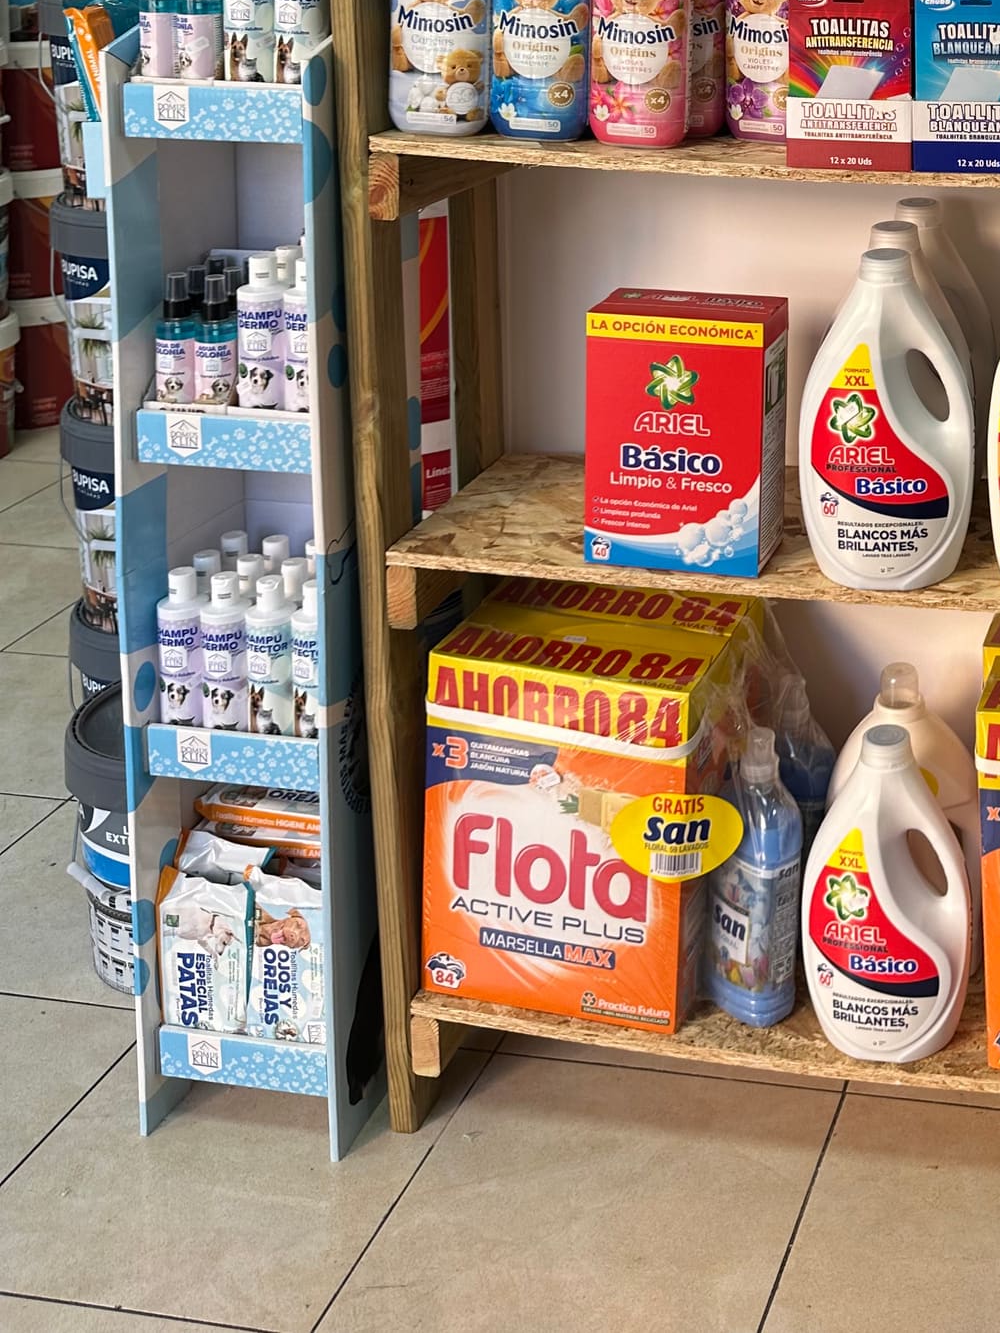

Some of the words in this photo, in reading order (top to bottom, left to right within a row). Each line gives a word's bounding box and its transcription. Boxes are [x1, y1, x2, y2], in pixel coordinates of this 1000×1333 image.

[398, 6, 473, 32] Mimosin
[500, 12, 577, 38] Mimosin
[598, 17, 675, 45] Mimosin
[810, 18, 890, 38] TOALLITAS
[610, 46, 656, 58] Origins
[741, 46, 783, 57] Origins
[806, 36, 894, 51] ANTITRANSFERENCIA
[158, 110, 186, 120] KLIN
[801, 102, 896, 120] TOALLITAS
[801, 119, 897, 132] ANTITRANSFERENCIA
[830, 156, 839, 164] 12
[858, 157, 872, 165] Uds
[957, 159, 967, 167] 12
[975, 159, 984, 167] 20
[986, 159, 1000, 168] Uds
[238, 309, 282, 320] CHAMPÚ
[239, 320, 279, 329] DERMO
[591, 319, 608, 330] LA
[613, 319, 665, 334] OPCIÓN
[196, 350, 231, 358] COLONIA
[844, 376, 869, 386] XXL
[634, 412, 710, 436] ARIEL
[171, 436, 198, 447] KLIN
[621, 444, 722, 475] Básico
[828, 446, 895, 466] ARIEL
[826, 464, 897, 473] PROFESSIONAL
[610, 472, 662, 488] Limpio
[666, 476, 677, 488] &
[681, 477, 732, 493] Fresco
[856, 477, 928, 496] Básico
[823, 503, 836, 515] 60
[837, 528, 897, 540] BLANCOS
[900, 528, 928, 539] MÁS
[838, 540, 918, 552] BRILLANTES,
[493, 580, 667, 620] AHORRO
[672, 596, 742, 628] 84
[439, 625, 632, 677] AHORRO
[637, 652, 704, 685] 84
[435, 665, 611, 744] AHORRO
[617, 691, 682, 749] 84
[470, 741, 530, 756] QUITAMANCHAS
[181, 752, 208, 763] KLIN
[470, 751, 510, 764] BLANCURA
[470, 761, 497, 773] JABÓN
[499, 765, 530, 778] NATURAL
[652, 797, 705, 815] GRATIS
[275, 819, 304, 829] HIGIENE
[452, 812, 648, 923] Flota
[839, 855, 862, 868] XXL
[450, 894, 554, 928] ACTIVE
[561, 917, 646, 946] PLUS
[824, 921, 886, 945] ARIEL
[481, 931, 562, 959] MARSELLA
[564, 946, 612, 968] MAX
[278, 950, 291, 993] OJOS
[850, 955, 918, 974] Básico
[195, 953, 207, 1013] ESPECIAL
[435, 968, 455, 986] 84
[177, 952, 199, 1026] PATAS
[263, 948, 279, 1025] OREJAS
[280, 999, 292, 1009] Y
[832, 999, 888, 1016] BLANCOS
[891, 1005, 919, 1016] MÁS
[833, 1011, 909, 1028] BRILLANTES,
[192, 1056, 218, 1066] KLIN
